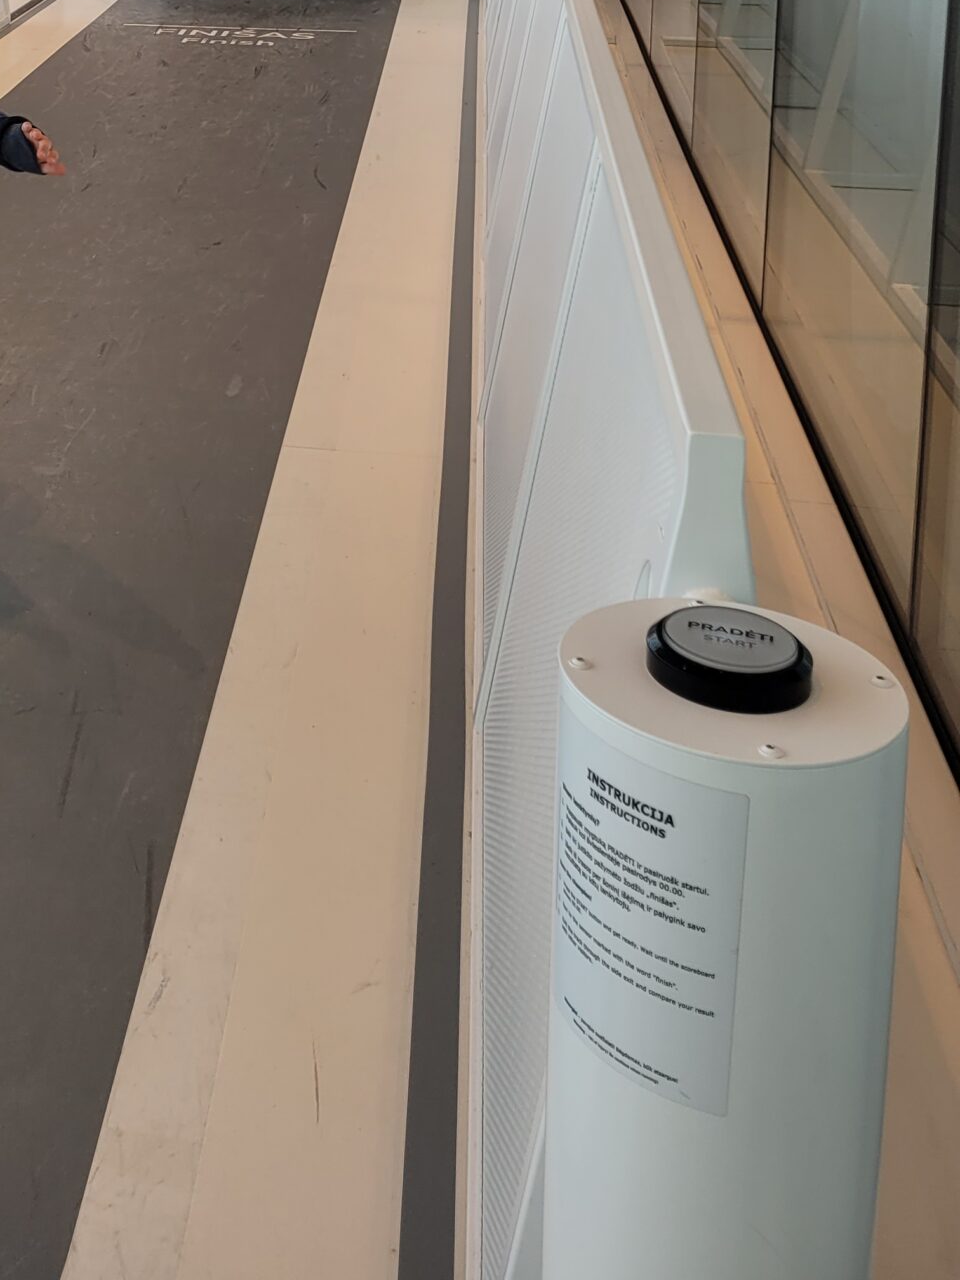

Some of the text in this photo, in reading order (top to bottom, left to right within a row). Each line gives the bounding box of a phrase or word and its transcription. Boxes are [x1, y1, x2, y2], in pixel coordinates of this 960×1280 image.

[181, 36, 275, 47] Finish
[687, 620, 774, 643] PRADĖTI
[703, 633, 757, 649] START
[587, 768, 675, 828] INSTRUKCIJA
[590, 787, 666, 839] INSTRUCTIONS
[653, 909, 685, 927] palygink
[687, 922, 706, 934] savo
[678, 1001, 694, 1012] your
